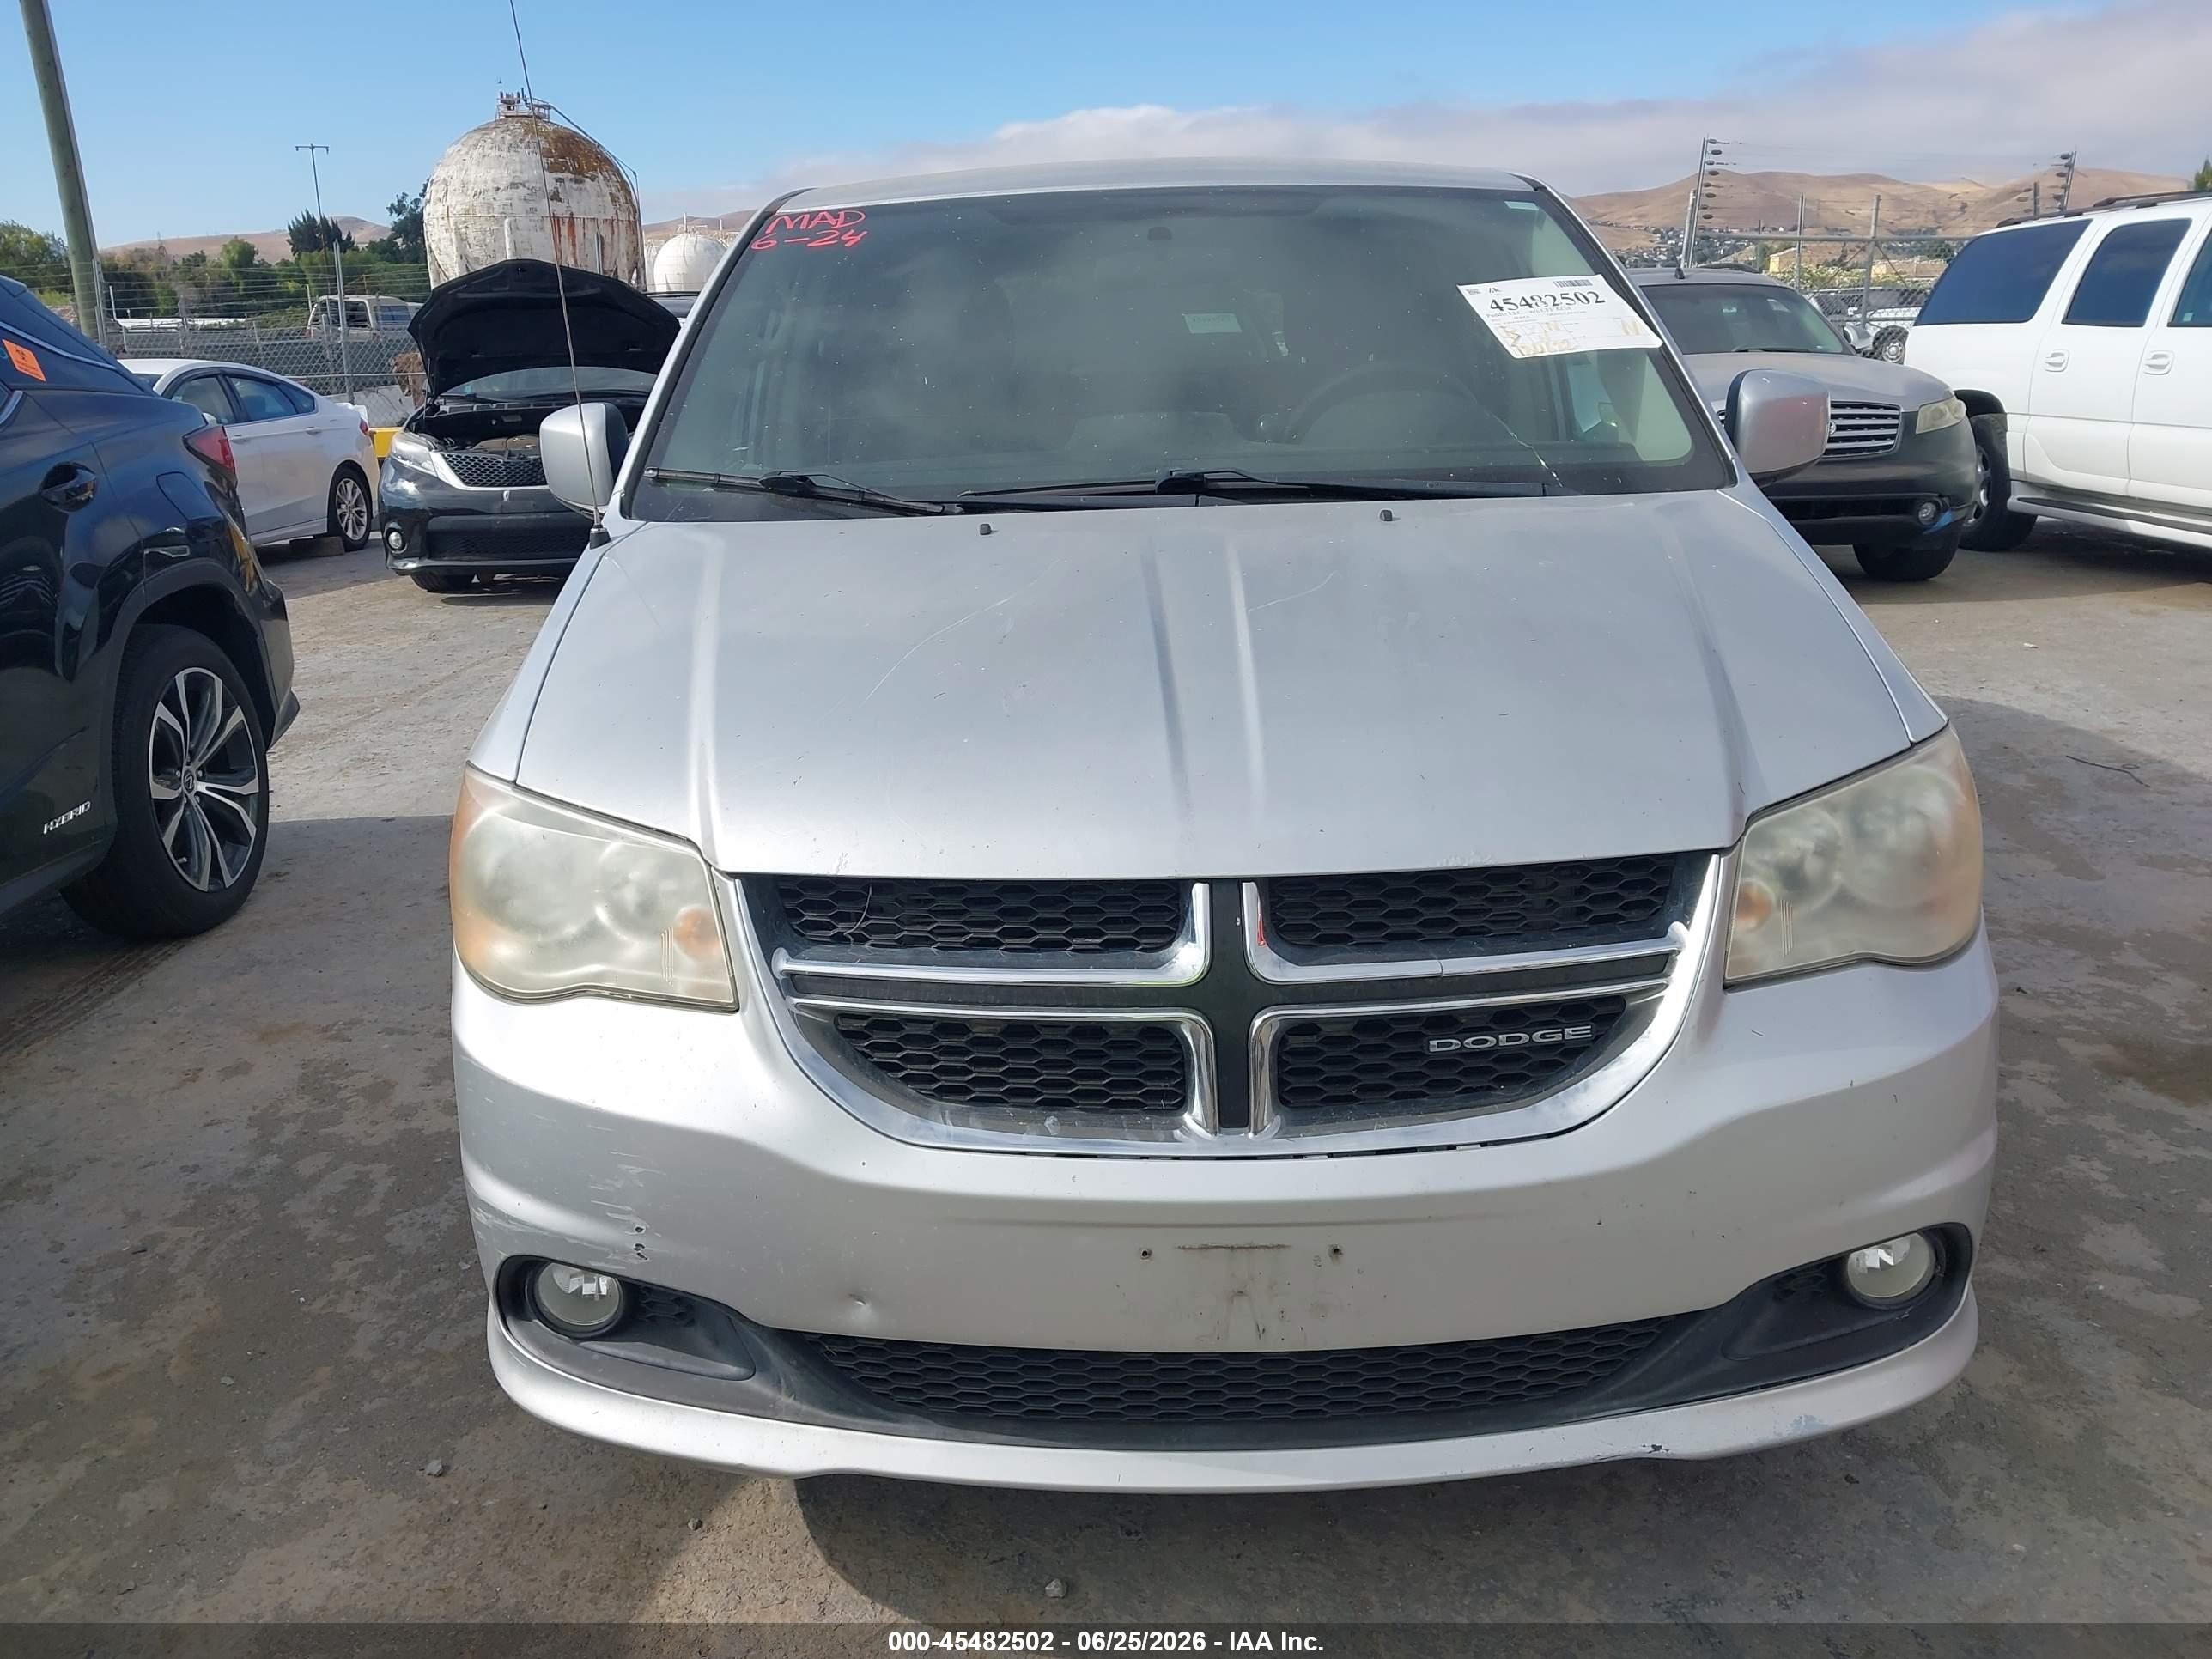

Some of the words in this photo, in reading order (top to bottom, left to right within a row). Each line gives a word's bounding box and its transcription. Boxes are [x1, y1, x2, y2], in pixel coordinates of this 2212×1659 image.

[765, 210, 866, 234] MAD
[1490, 291, 1606, 312] 45482502
[43, 800, 91, 834] HYBRID
[1429, 1025, 1592, 1052] DODGE
